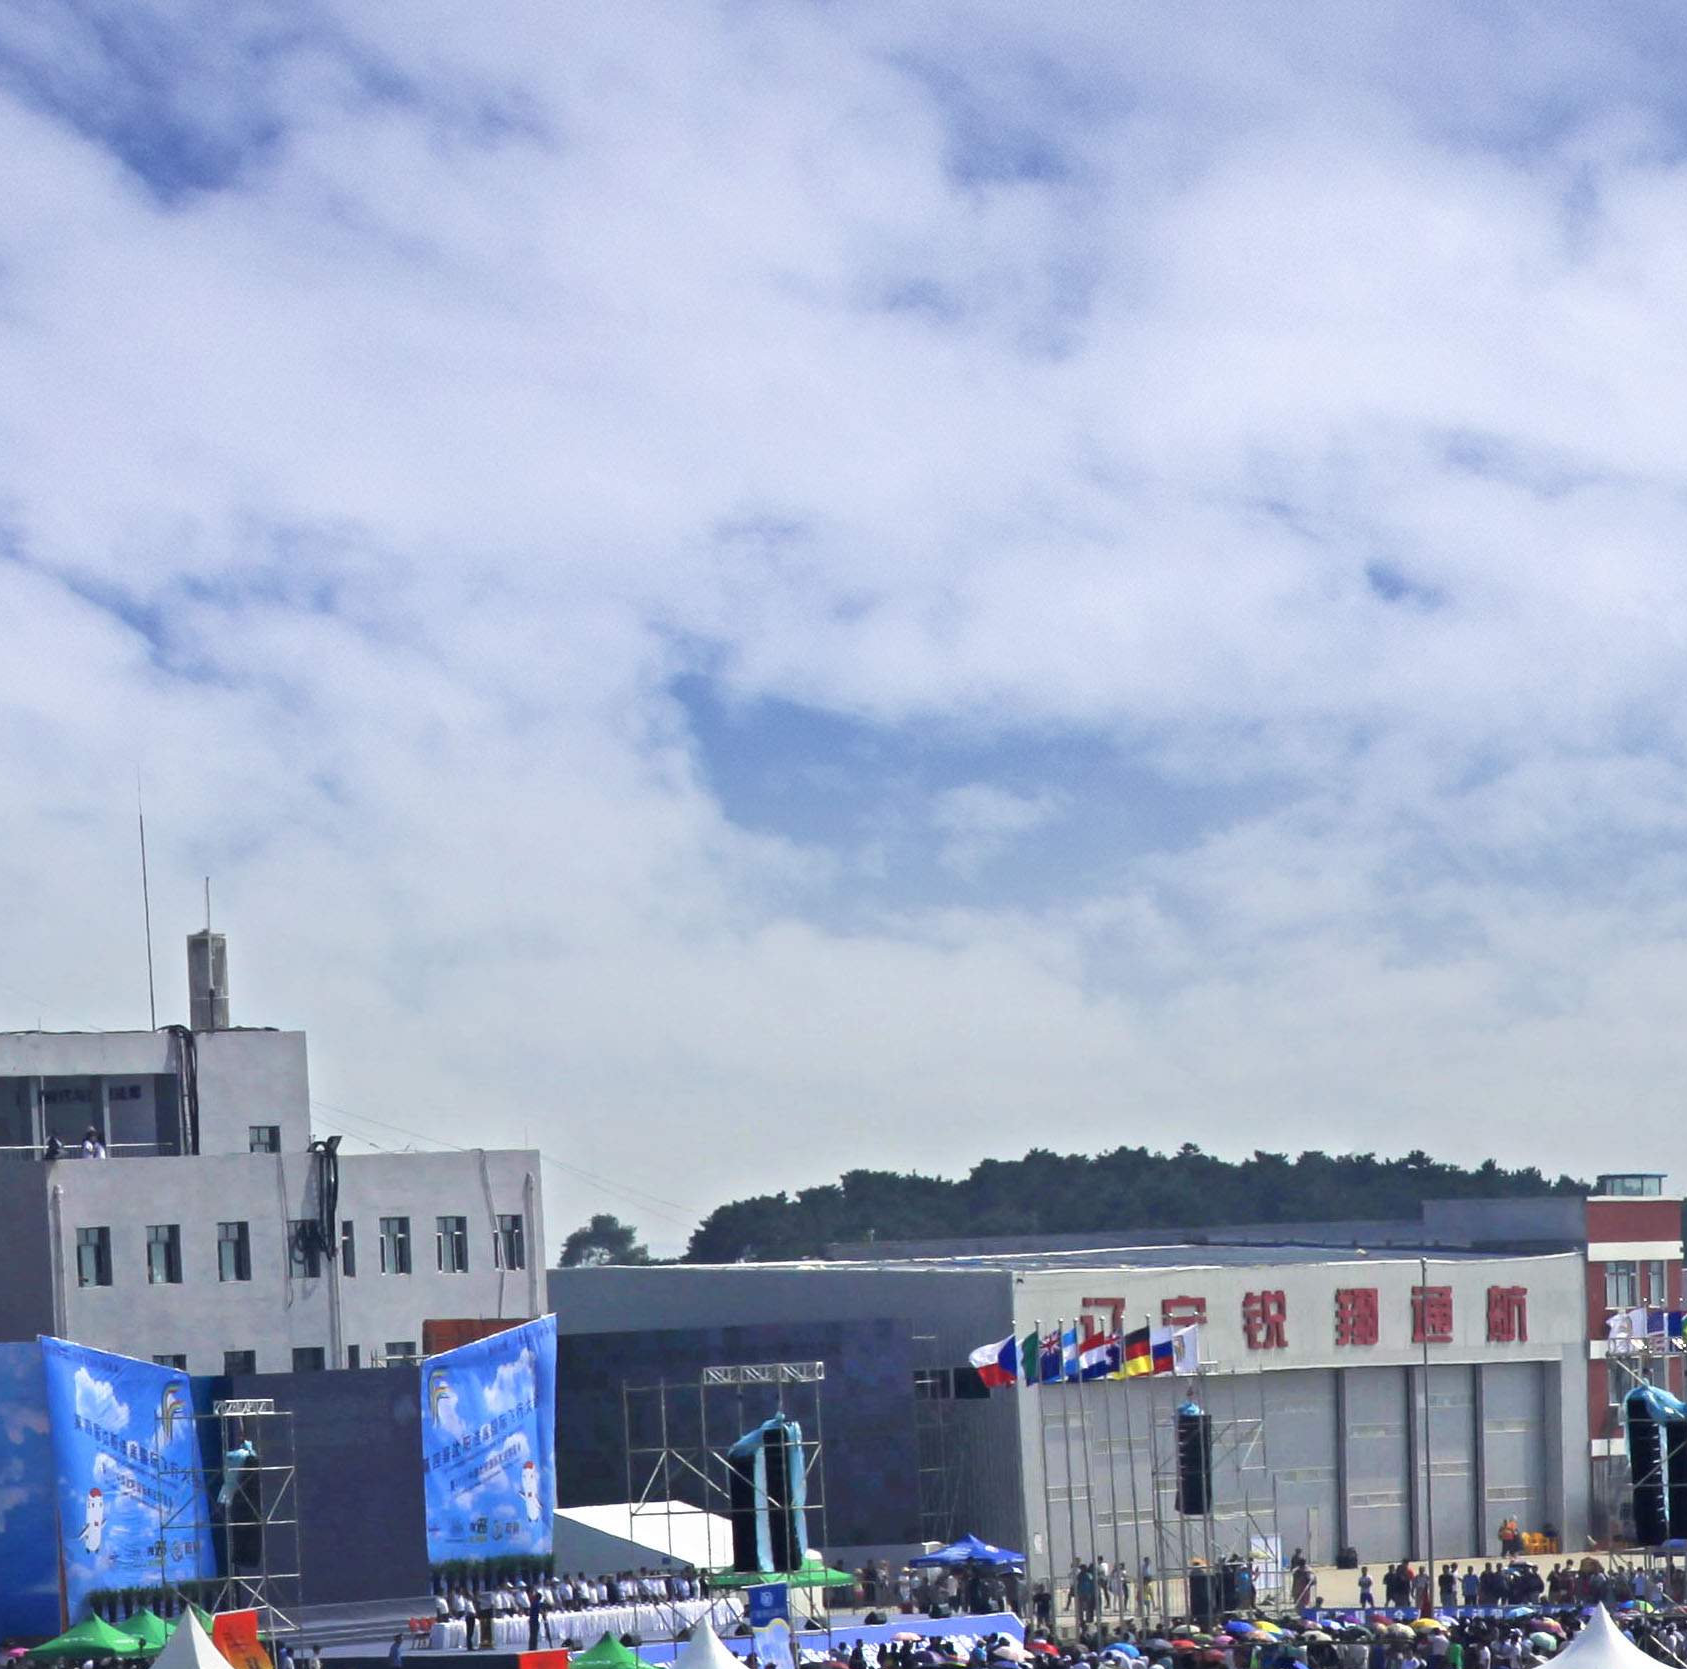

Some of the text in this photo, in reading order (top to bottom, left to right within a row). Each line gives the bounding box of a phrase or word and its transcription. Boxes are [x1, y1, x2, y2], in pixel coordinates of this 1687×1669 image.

[1081, 1285, 1529, 1349] 辽宁锐翔通航
